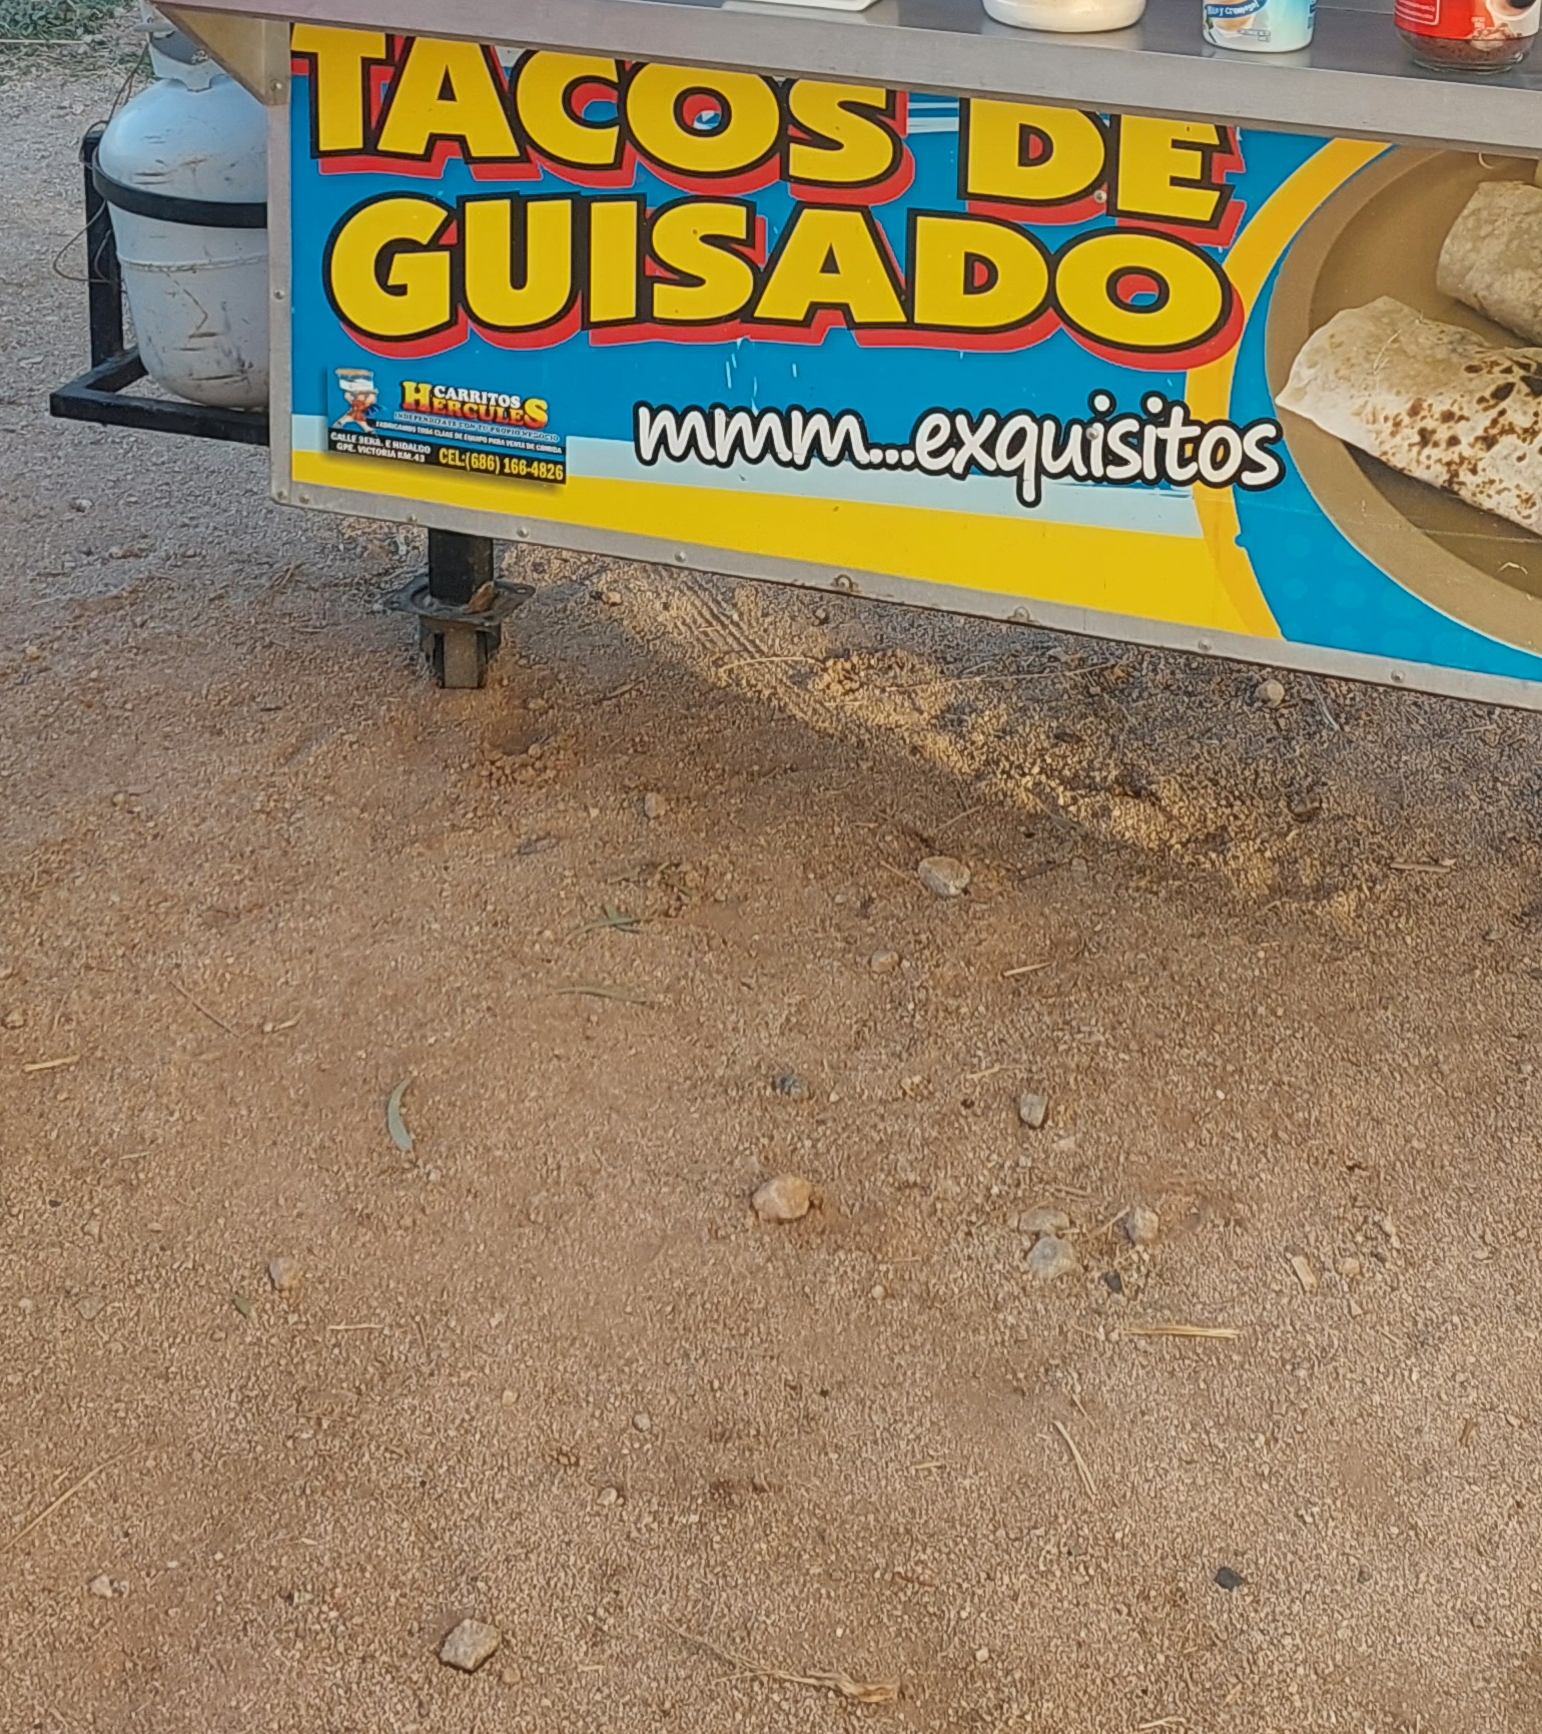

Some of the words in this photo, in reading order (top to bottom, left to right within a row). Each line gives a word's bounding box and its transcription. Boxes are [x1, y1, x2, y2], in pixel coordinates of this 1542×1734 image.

[291, 23, 907, 191] TACOS
[957, 97, 1239, 234] DE
[323, 190, 1237, 358] GUISADO
[401, 380, 549, 430] HERCULES
[433, 384, 522, 409] CARRITOS
[330, 431, 357, 444] CALLE
[392, 440, 431, 454] HIDALGO
[356, 445, 397, 459] VICTORIA
[503, 457, 564, 481] 166-4826
